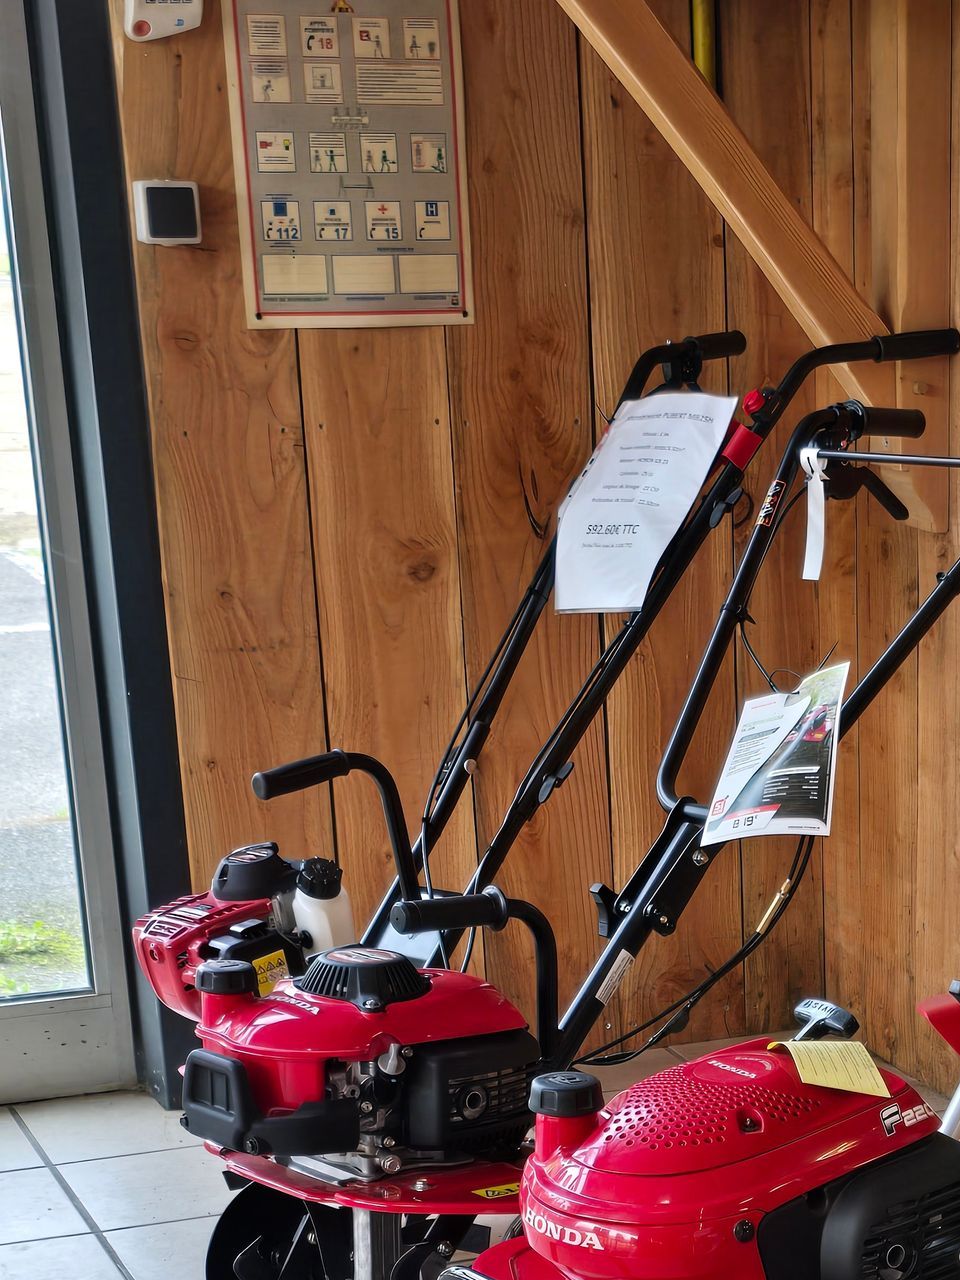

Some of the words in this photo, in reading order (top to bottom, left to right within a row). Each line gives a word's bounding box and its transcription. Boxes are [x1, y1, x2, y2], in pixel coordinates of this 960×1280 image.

[318, 37, 334, 50] 18
[426, 203, 438, 216] H
[276, 227, 299, 240] 112
[334, 227, 349, 240] 17
[384, 227, 399, 240] 15
[622, 524, 641, 535] TTC
[706, 1059, 758, 1079] HONDA
[523, 1208, 605, 1251] HONDA
